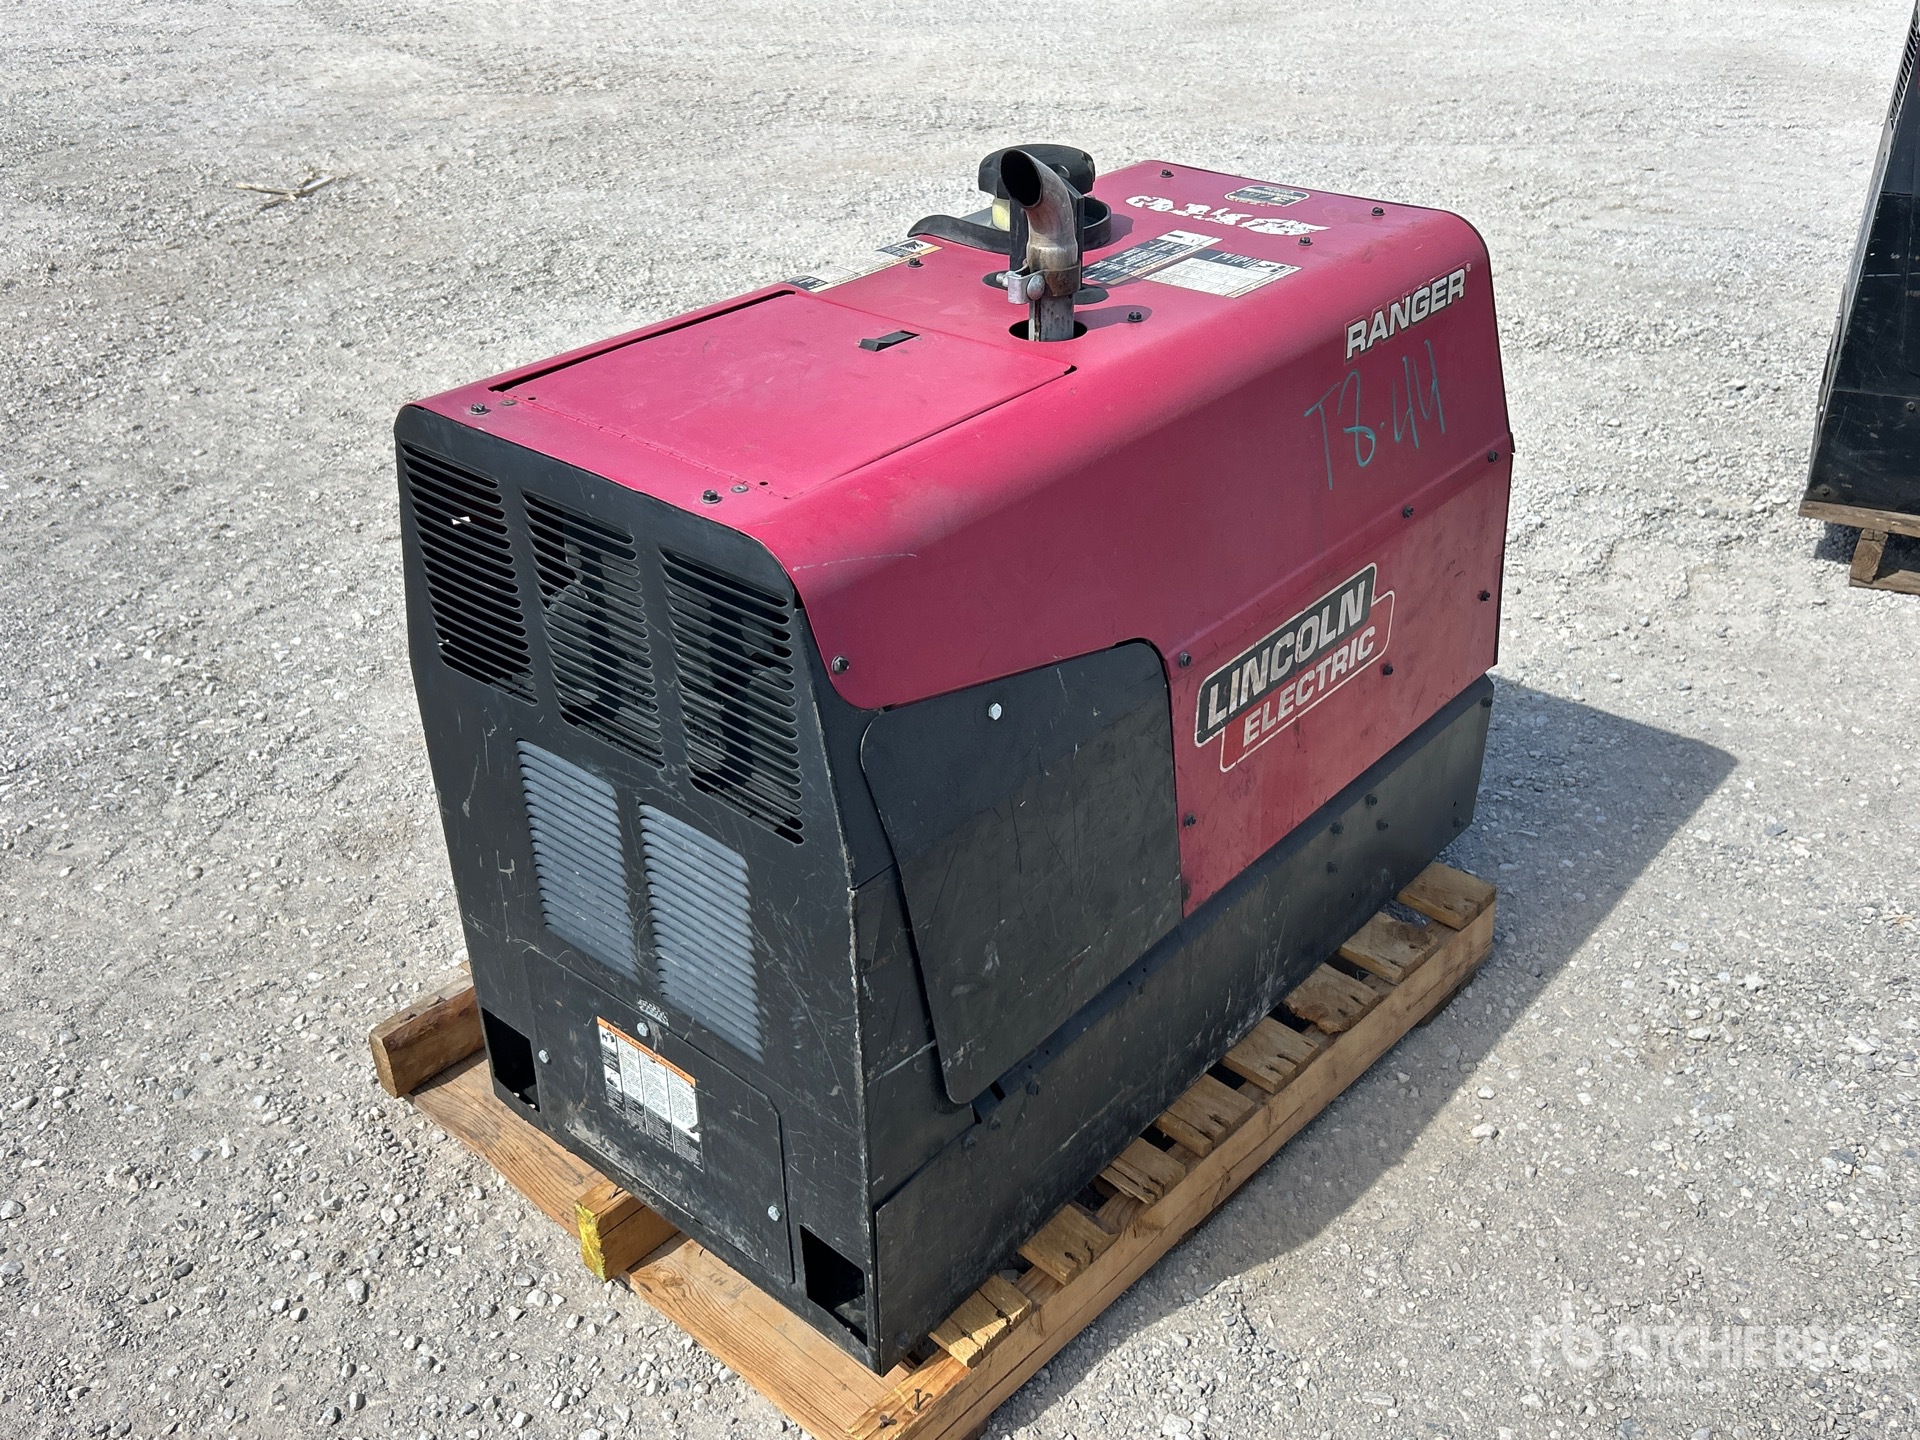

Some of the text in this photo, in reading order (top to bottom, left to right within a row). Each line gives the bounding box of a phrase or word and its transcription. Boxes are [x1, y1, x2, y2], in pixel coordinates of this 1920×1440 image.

[1346, 267, 1466, 360] RANGER
[1208, 580, 1365, 730] LINCOLN
[1243, 626, 1375, 748] ELECTRIC
